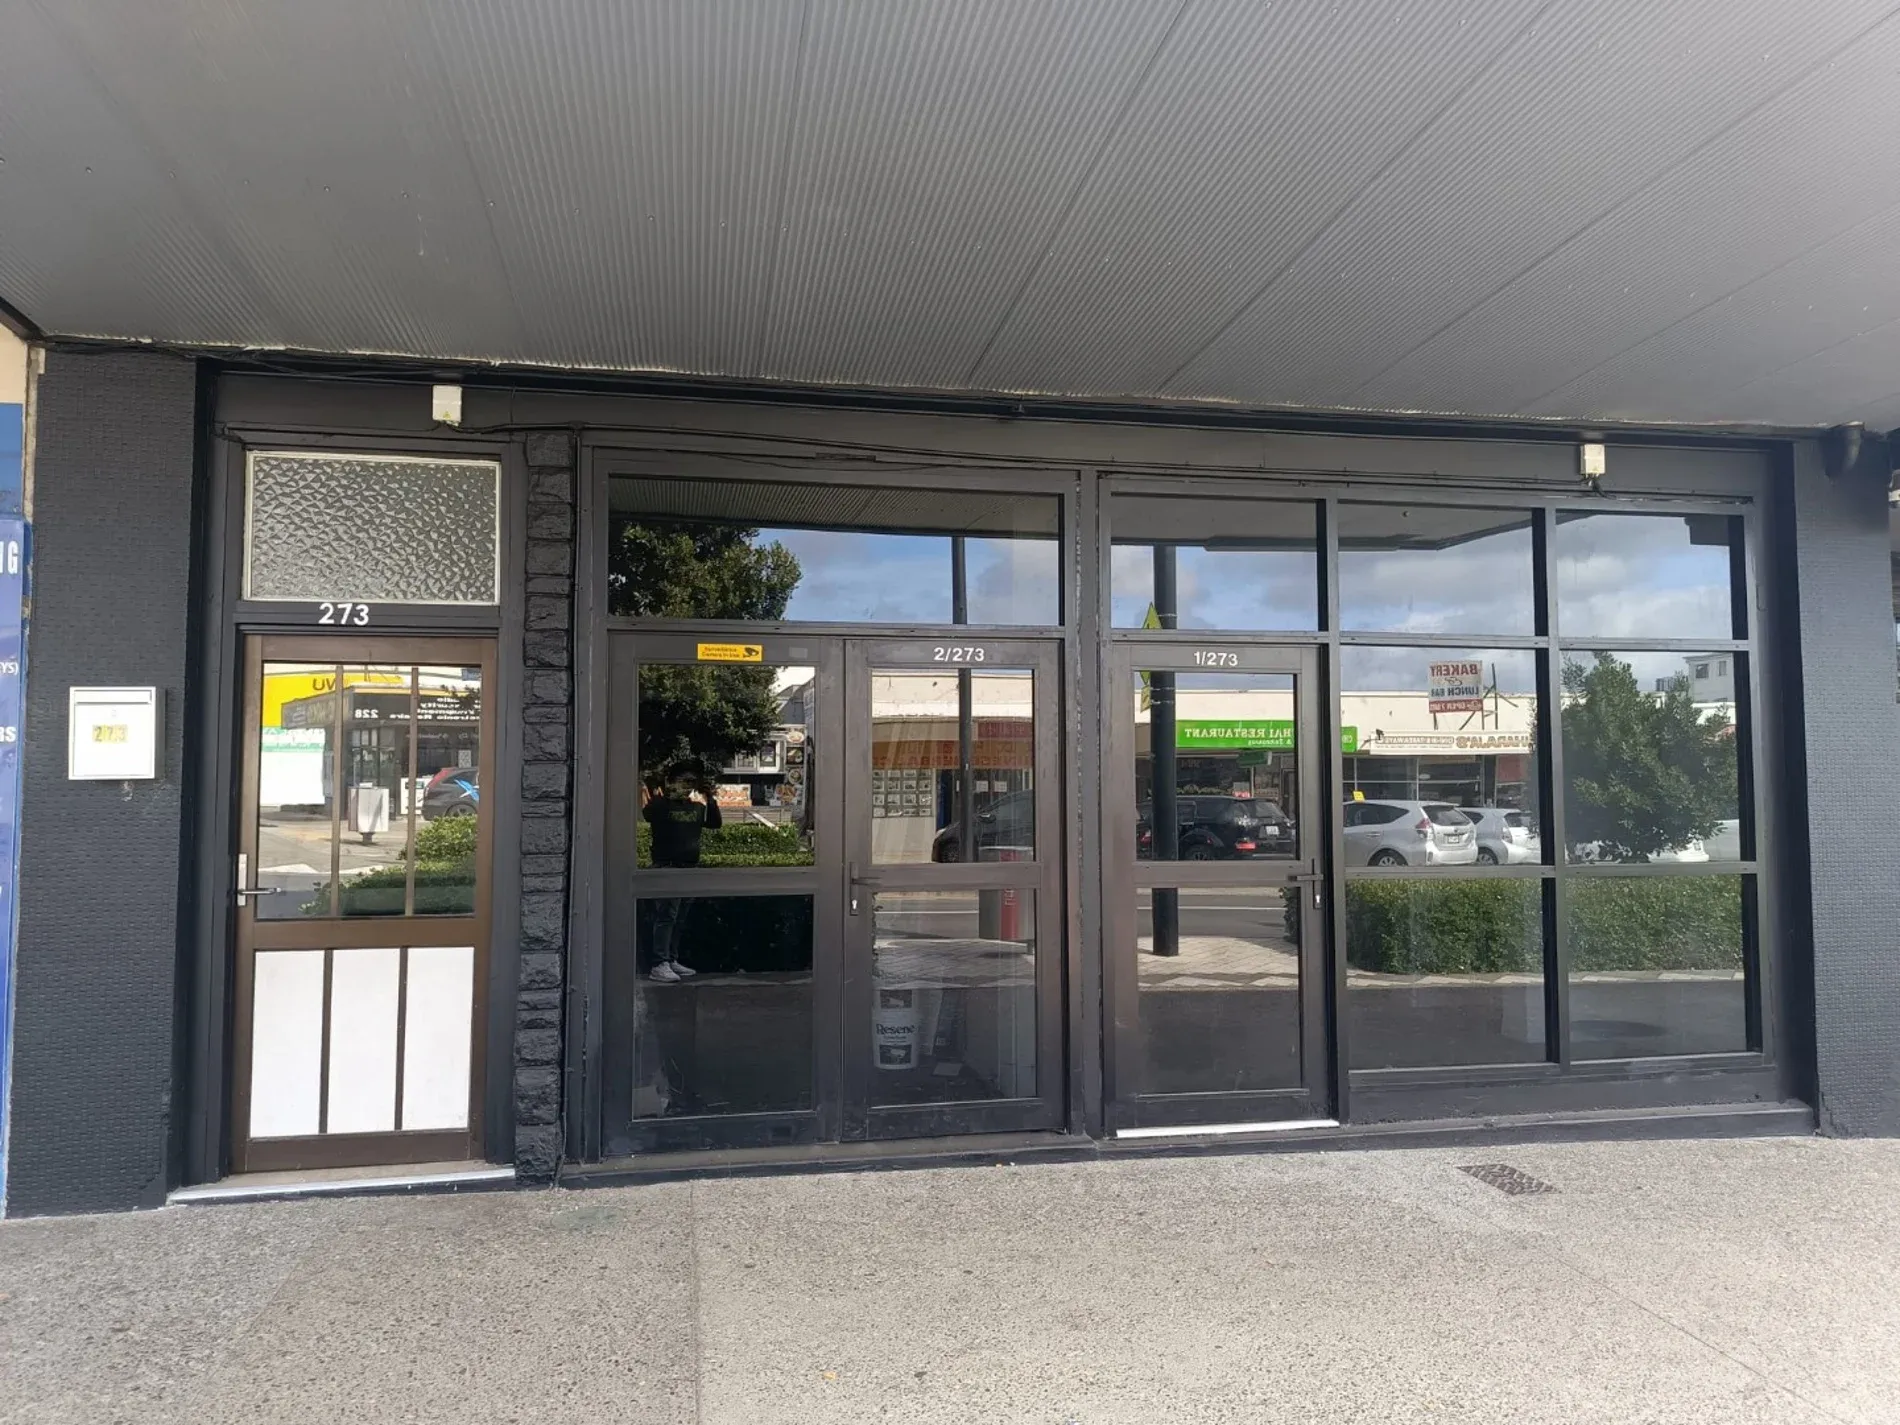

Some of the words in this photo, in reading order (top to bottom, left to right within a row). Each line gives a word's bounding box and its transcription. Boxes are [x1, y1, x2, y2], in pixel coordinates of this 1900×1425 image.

[319, 602, 369, 626] 273
[933, 647, 985, 662] 2/273
[1193, 651, 1238, 666] 1/273
[94, 725, 126, 742] 273
